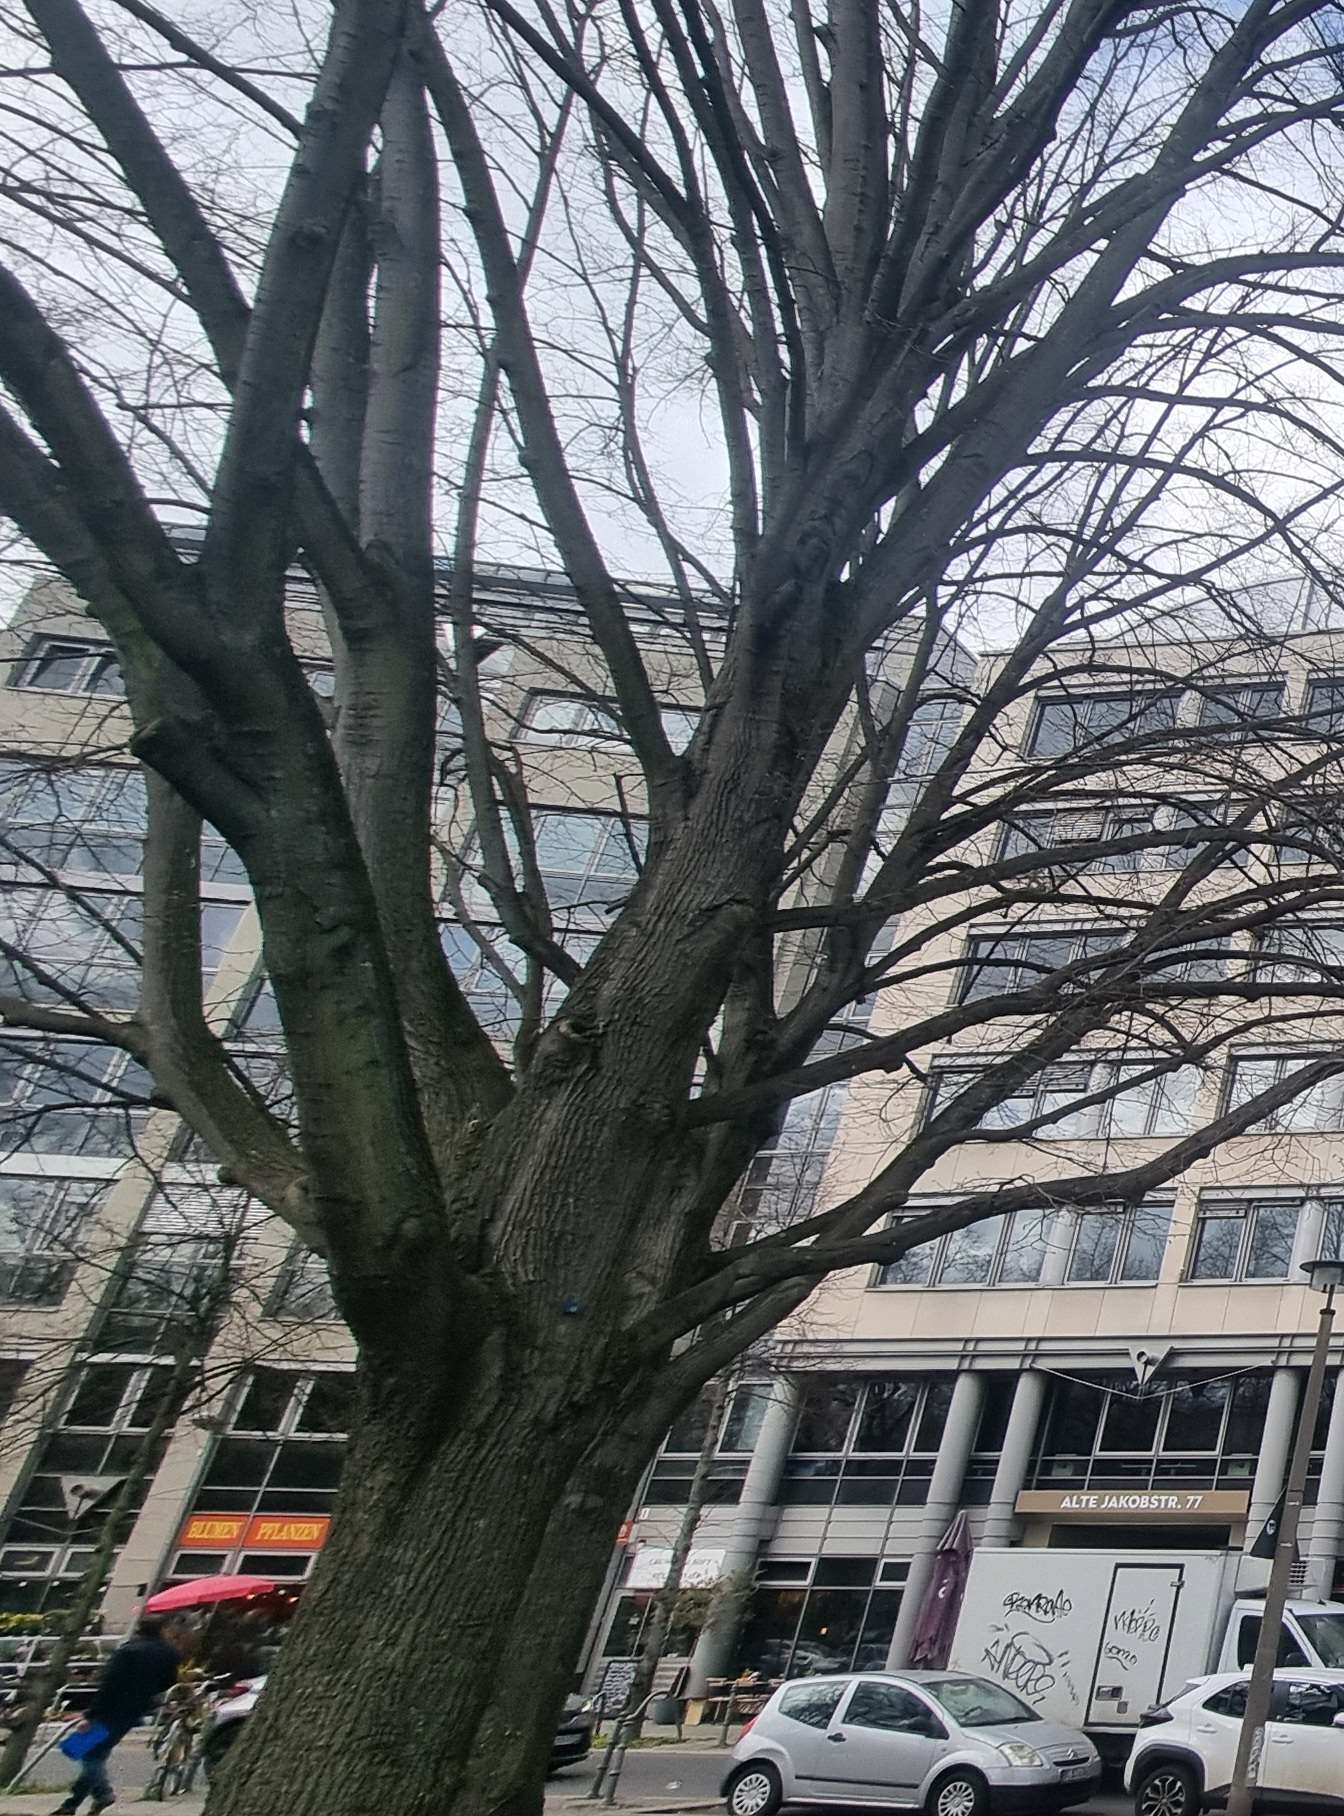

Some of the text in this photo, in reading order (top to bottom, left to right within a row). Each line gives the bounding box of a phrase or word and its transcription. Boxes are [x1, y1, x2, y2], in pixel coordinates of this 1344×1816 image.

[1060, 1495, 1204, 1509] ALTE JAKOBSTR. 77
[255, 1522, 324, 1541] PFLANZEN
